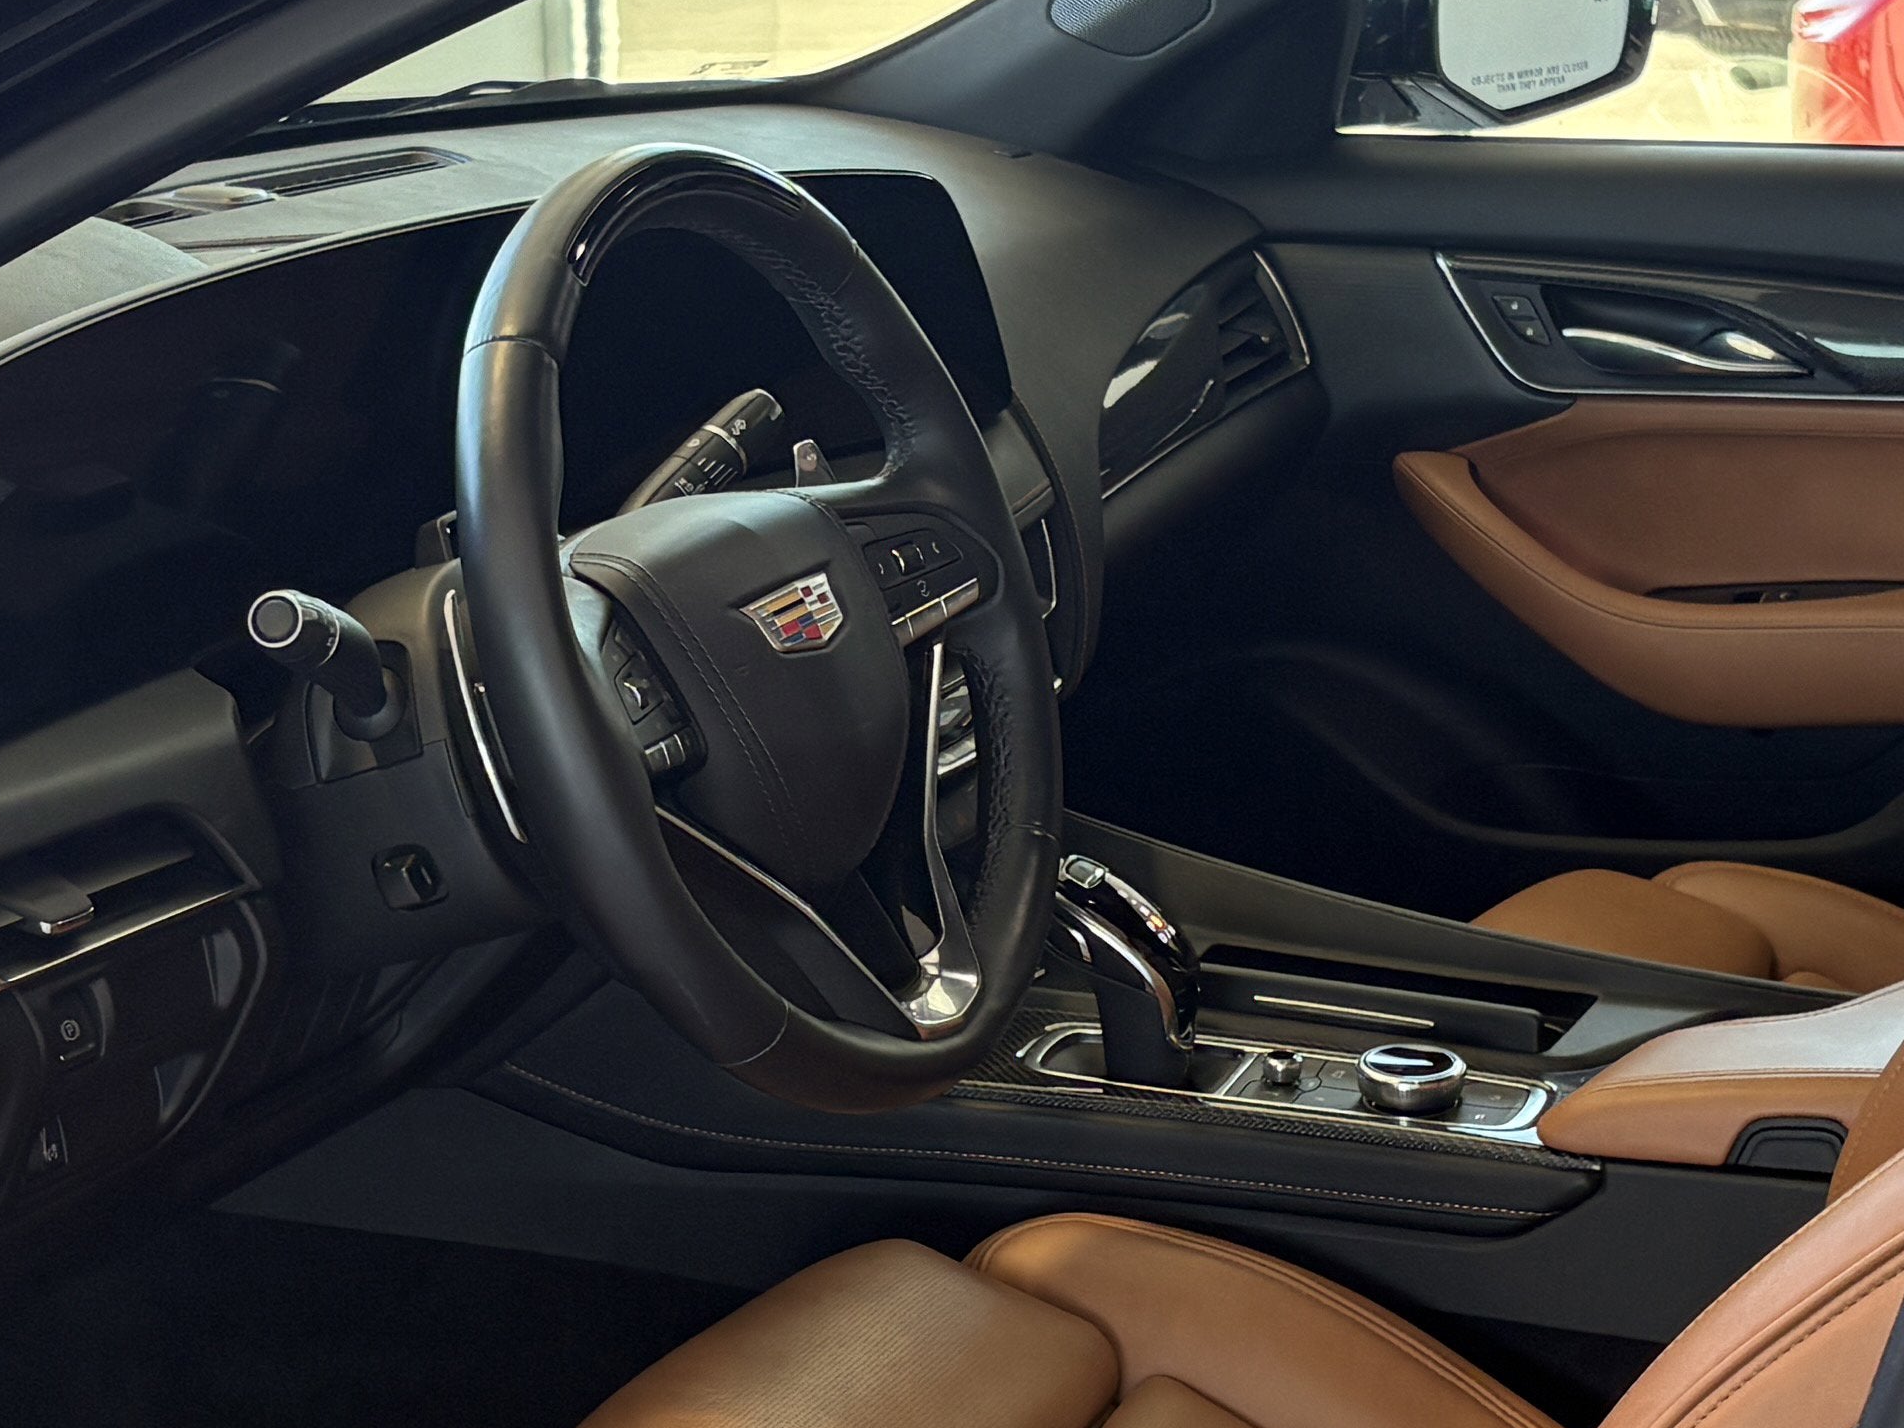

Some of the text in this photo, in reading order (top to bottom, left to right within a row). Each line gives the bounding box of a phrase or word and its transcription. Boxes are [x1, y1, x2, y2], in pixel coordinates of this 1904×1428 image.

[1471, 60, 1589, 86] OBJECTS IN MIRROR ARE CLOSER
[1497, 82, 1516, 92] THAN
[1519, 79, 1536, 90] THEY
